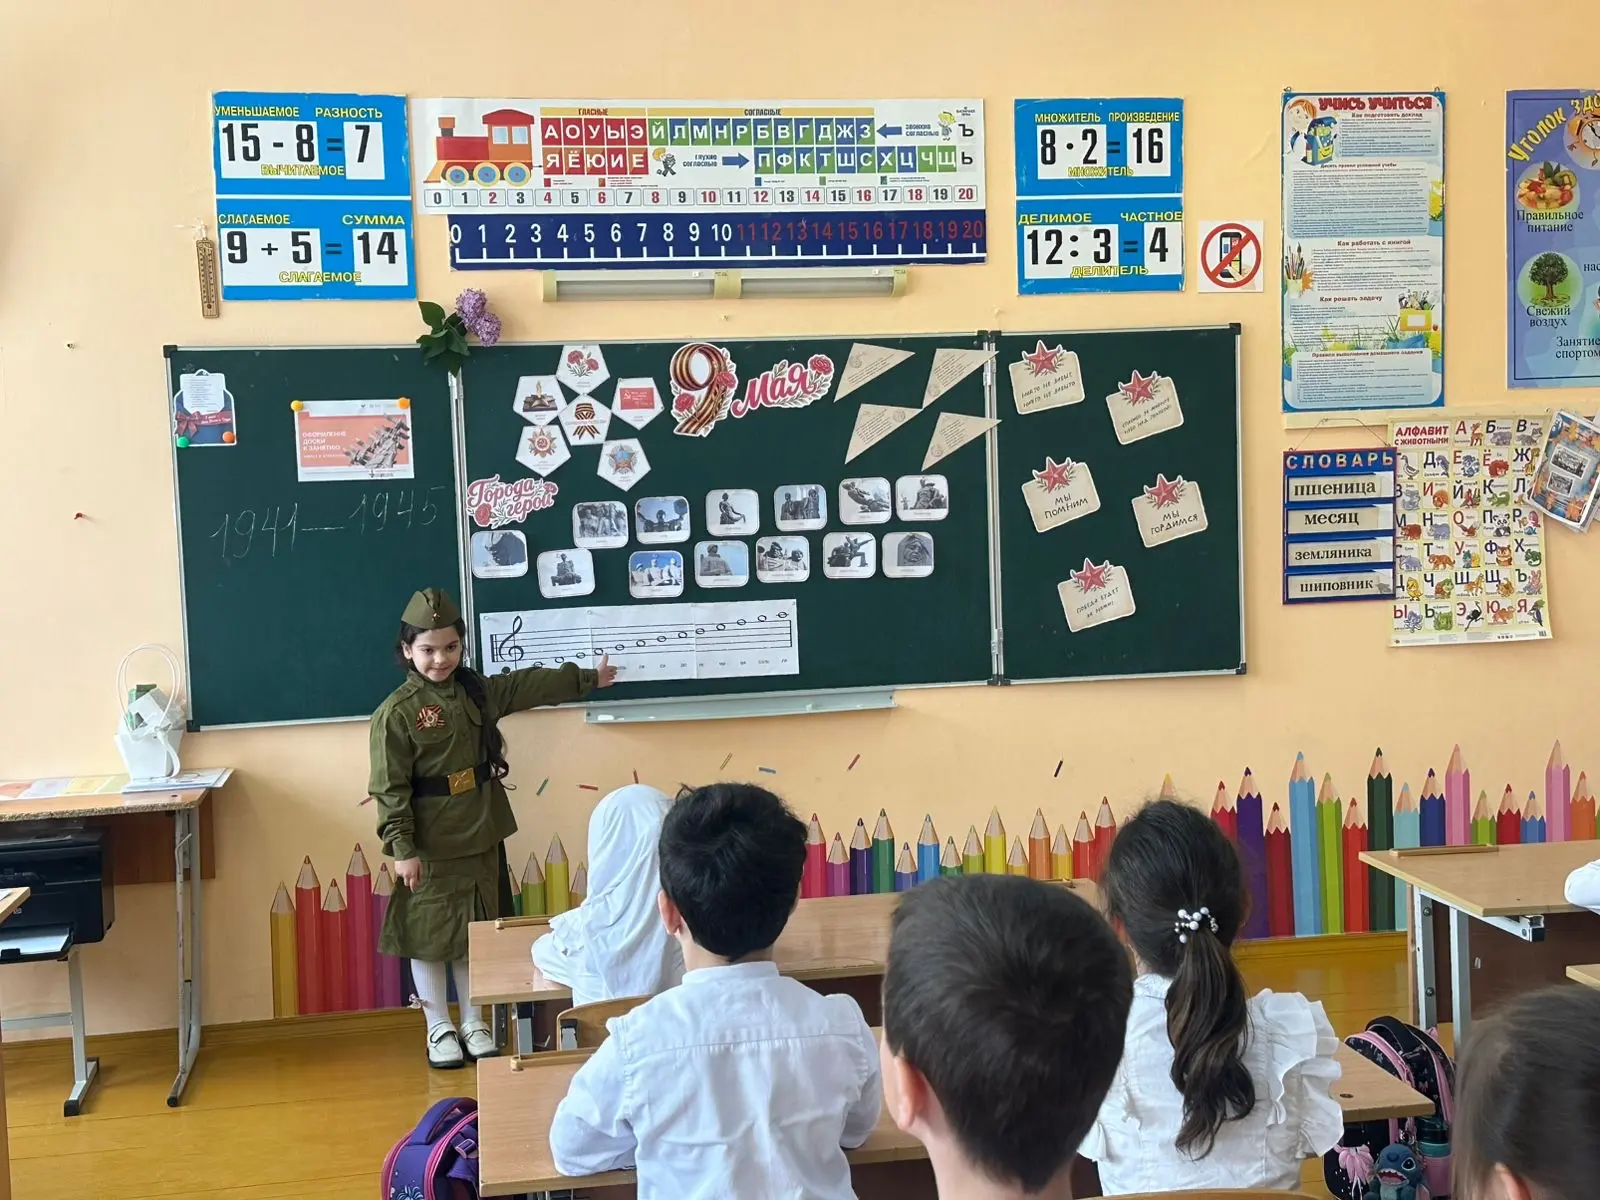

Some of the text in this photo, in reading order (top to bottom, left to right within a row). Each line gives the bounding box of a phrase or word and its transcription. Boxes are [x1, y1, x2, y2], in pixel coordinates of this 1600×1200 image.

[1318, 96, 1432, 110] УЧИСЬ УЧИТЬСЯ
[215, 106, 383, 118] УМЕНЬШАЕМОЕ РАЗНОСТЬ
[578, 108, 608, 116] ГЛАСНЫЕ
[1034, 112, 1180, 123] МНОЖИТЕЛЬ ПРОИЗВЕДЕНИЕ
[544, 121, 871, 140] А О У Ы Э Й Л М Н Р Б В Г Д Ж З
[958, 124, 974, 137] Ъ
[222, 123, 370, 163] 15 8 7
[1040, 128, 1163, 165] 8 2 16
[546, 151, 644, 168] Я Ё Ю И Е
[758, 152, 956, 168] П Ф К Т Ш С Х Ц Ч Щ
[962, 152, 973, 164] Ь
[261, 164, 345, 176] ВЫЧИТАЕМОЕ
[1068, 166, 1134, 177] МНОЖИТЕЛЬ
[434, 188, 974, 204] 0 1 2 3 4 5 6 7 8 9 10 11 12 13 14 15 16 17 18 19 20
[218, 214, 405, 225] СЛАГАЕМОЕ СУММА
[1018, 211, 1182, 224] ДЕЛИМОЕ ЧАСТНОЕ
[1516, 210, 1584, 224] Правильное
[450, 223, 732, 243] 0 1 2 3 4 5 6 7 8 9 10
[1528, 222, 1574, 233] питание
[226, 231, 398, 264] 9 5 14
[1027, 227, 1168, 265] 12 3 4
[279, 271, 362, 282] СЛАГАЕМОЕ
[1071, 266, 1148, 278] ДЕЛИТЕЛЬ
[1526, 305, 1570, 316] Свежий
[1530, 316, 1568, 328] воздух
[670, 343, 816, 435] 9 Мая
[1396, 426, 1449, 437] АЛФАВИТ
[1456, 420, 1527, 435] А Б В
[1400, 437, 1449, 445] ЖИВОТНЫМИ
[1286, 452, 1393, 469] СЛОВАРЬ
[1424, 448, 1530, 469] Д Е Ё Ж
[1294, 481, 1376, 496] пшеница
[1424, 478, 1526, 500] И Й К Л
[1054, 493, 1072, 506] МЫ
[1044, 497, 1088, 519] ПОМНИМ
[209, 502, 299, 559] 1941
[349, 486, 446, 535] 1945
[1162, 510, 1180, 522] МЫ
[1304, 512, 1359, 526] месяц
[1423, 508, 1522, 526] Н О П Р
[1150, 513, 1198, 535] ГОРДИМСЯ
[1295, 548, 1372, 560] земляника
[1300, 580, 1374, 592] шиповник
